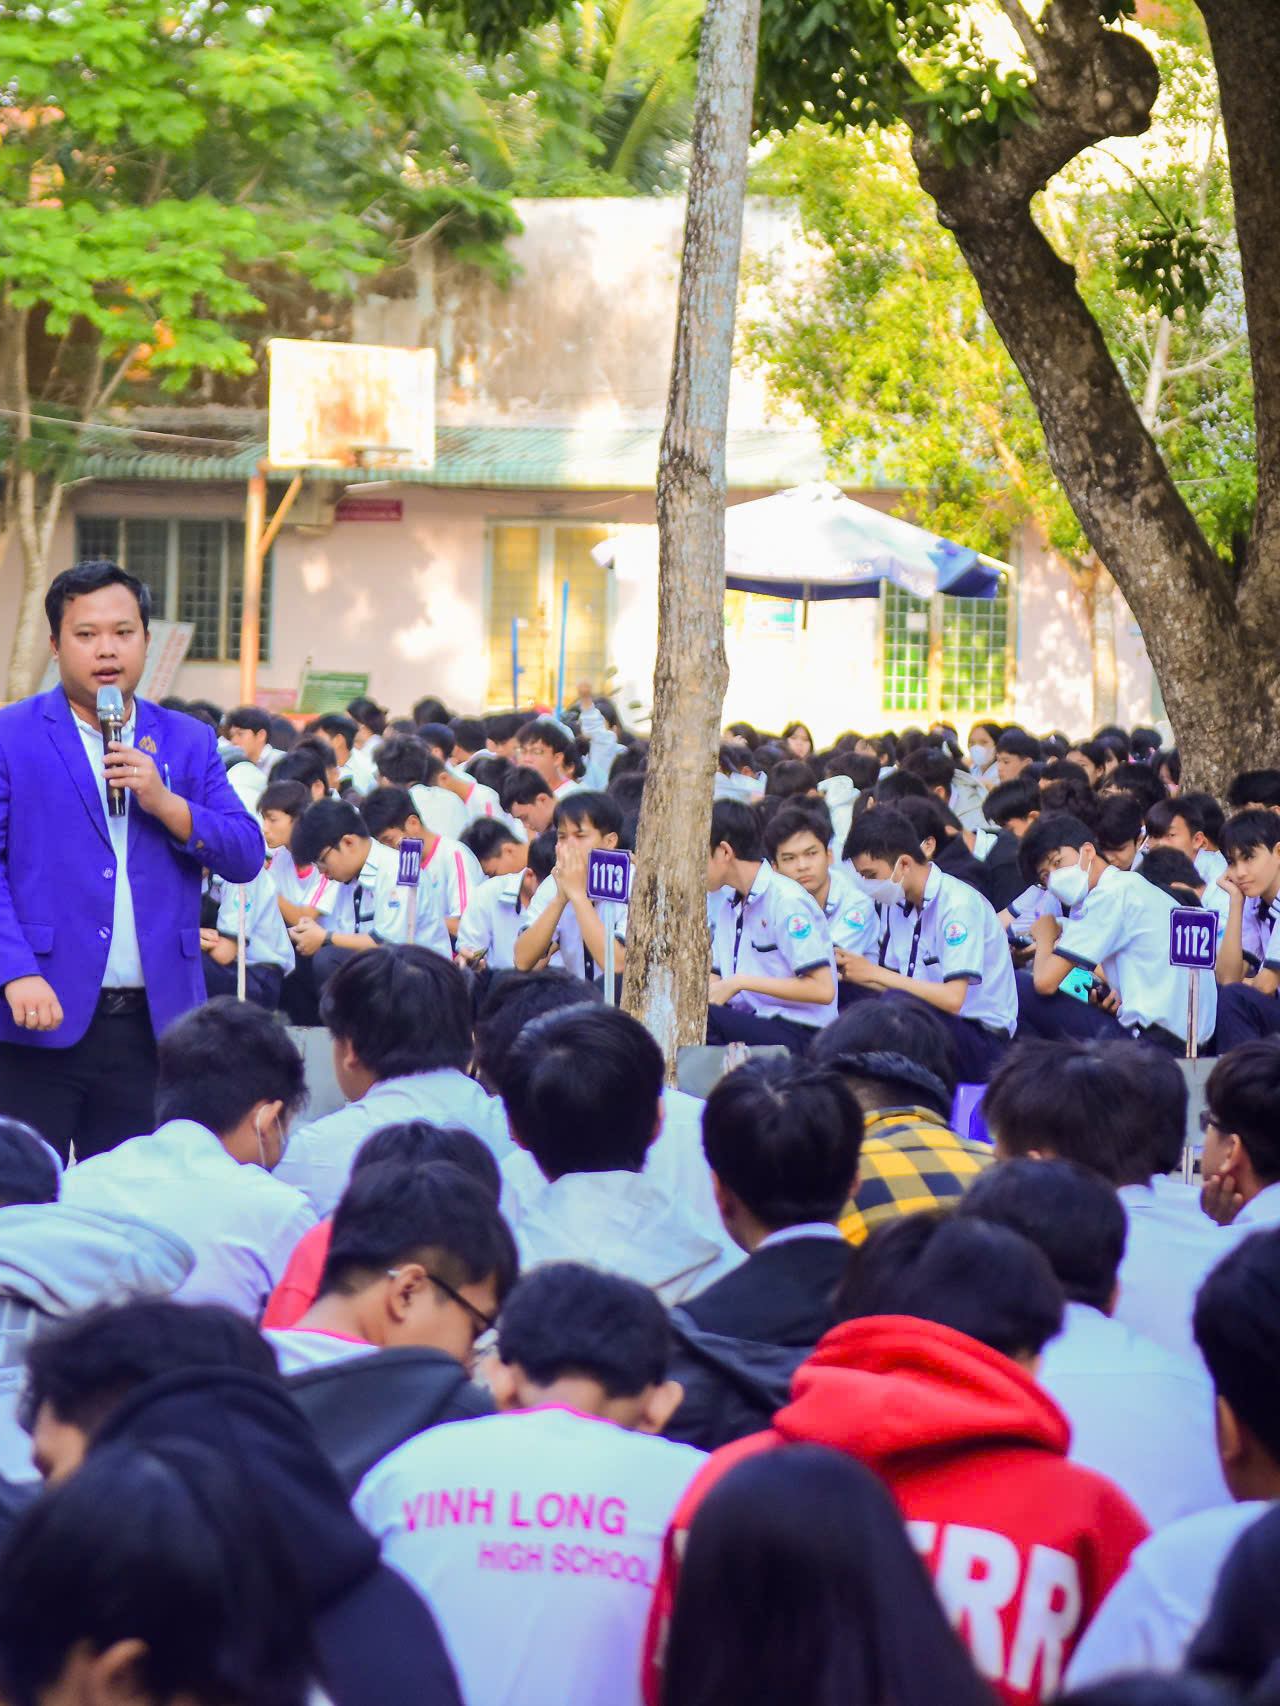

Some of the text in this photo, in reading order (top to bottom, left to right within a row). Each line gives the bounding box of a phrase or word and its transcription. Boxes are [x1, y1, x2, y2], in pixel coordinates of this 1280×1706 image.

[592, 861, 624, 894] 11T3
[1175, 924, 1210, 958] 11T2
[402, 1487, 628, 1537] VINH LONG
[477, 1541, 656, 1589] HIGH SCHOOL
